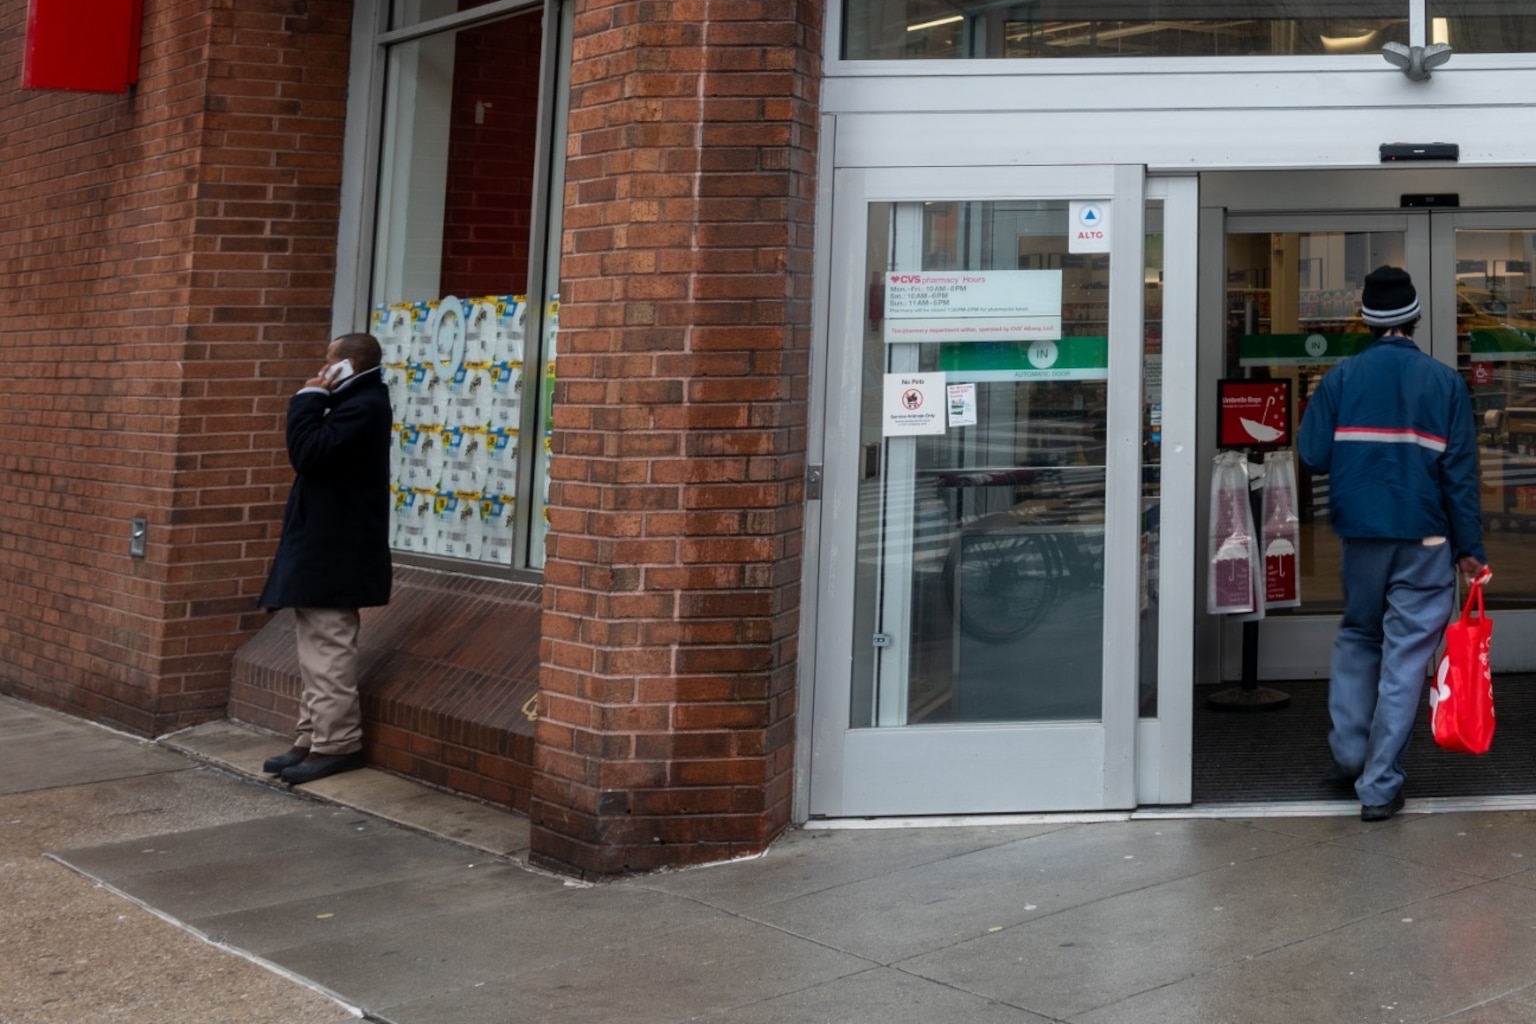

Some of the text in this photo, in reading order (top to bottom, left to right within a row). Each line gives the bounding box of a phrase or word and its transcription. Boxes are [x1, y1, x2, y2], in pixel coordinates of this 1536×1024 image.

[900, 275, 986, 285] CVS pharmacy Hours
[1036, 349, 1048, 359] IN
